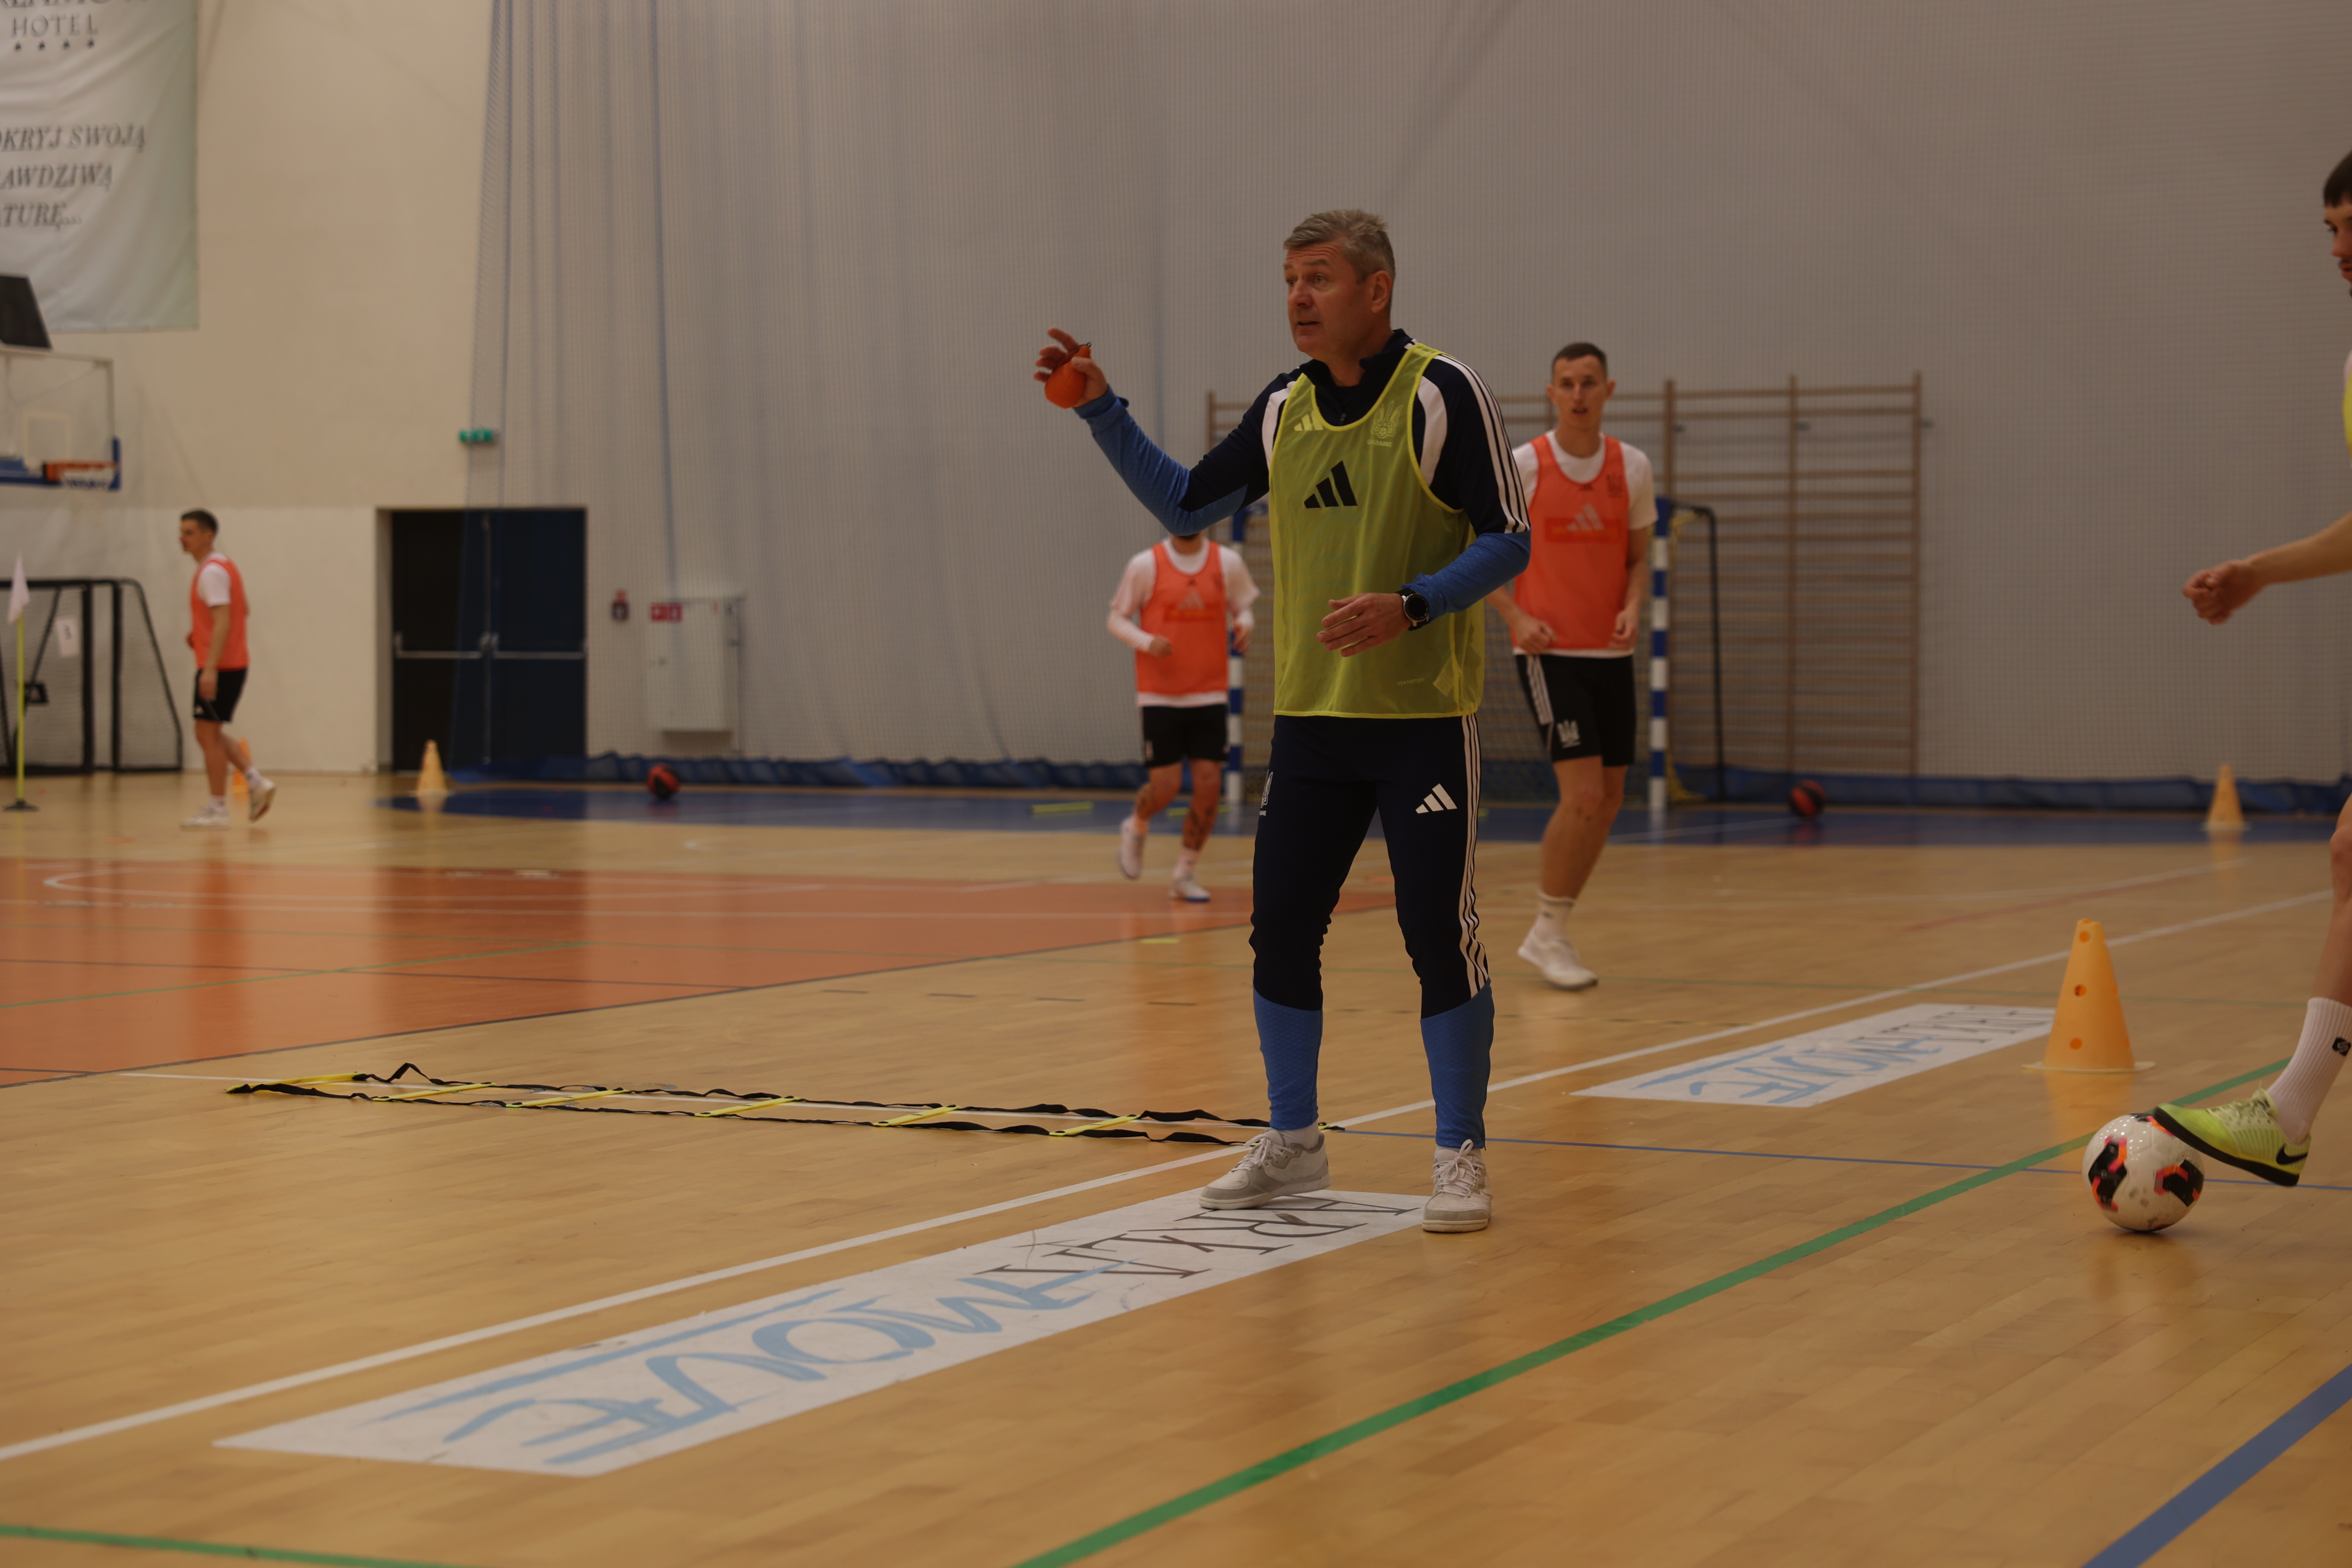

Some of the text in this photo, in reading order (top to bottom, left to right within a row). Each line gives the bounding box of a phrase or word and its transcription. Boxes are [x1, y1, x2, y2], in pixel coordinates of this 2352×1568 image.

[11, 14, 98, 38] HOTEL
[0, 123, 145, 153] KRYJ SWOJĄ
[0, 162, 113, 192] AWDZIWĄ
[0, 202, 83, 232] TURĘ...
